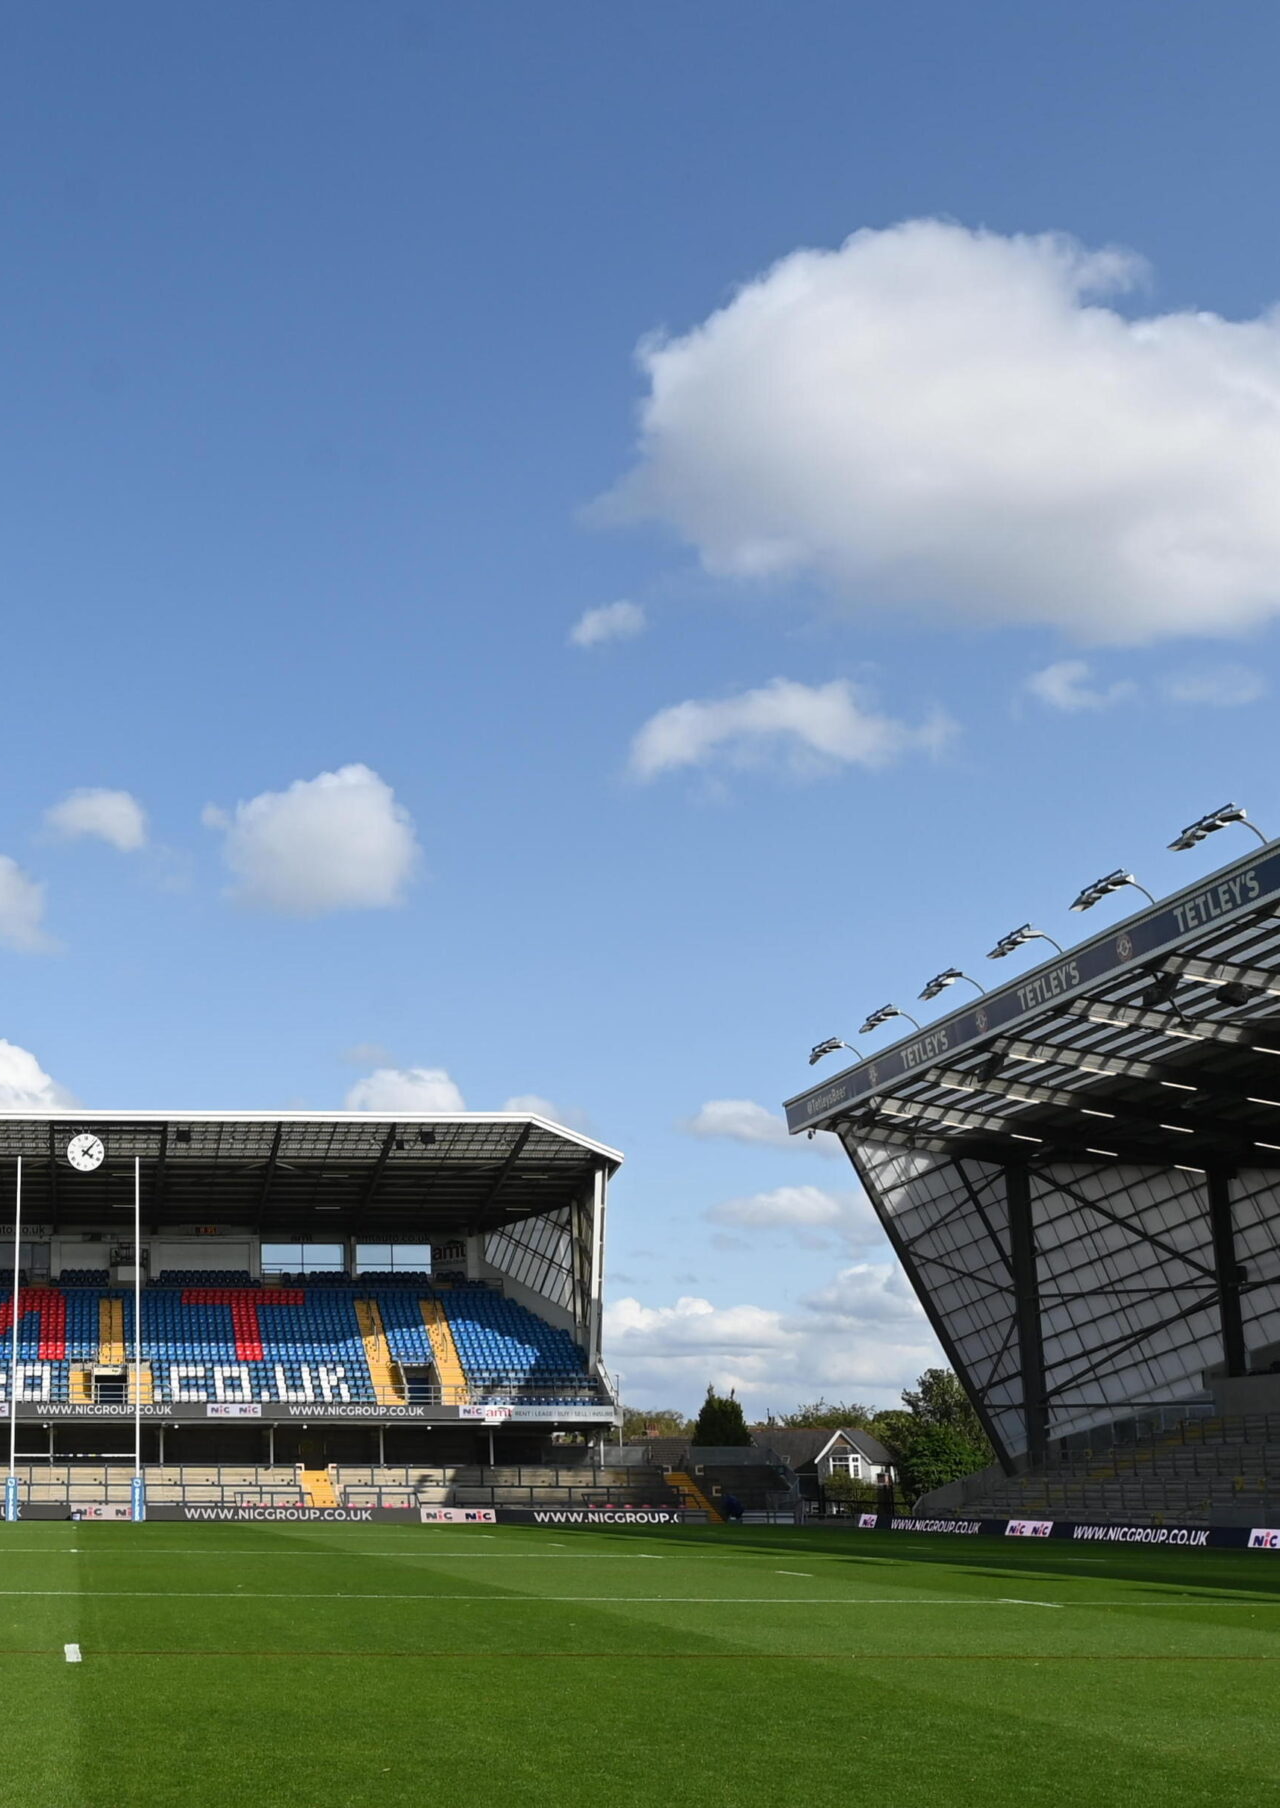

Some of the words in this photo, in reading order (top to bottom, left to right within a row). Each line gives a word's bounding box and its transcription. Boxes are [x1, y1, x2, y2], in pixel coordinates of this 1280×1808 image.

[1173, 870, 1260, 933] TETLEY'S
[1017, 961, 1080, 1011] TETLEY'S
[900, 1031, 949, 1070] TETLEY'S
[433, 1243, 466, 1261] amt
[37, 1404, 172, 1414] WWW.NICGROUP.CO.UK
[289, 1404, 424, 1414] WWW.NICGROUP.CO.UK
[184, 1507, 373, 1520] WWW.NICGROUP.CO.UK
[891, 1519, 982, 1534] WWW.NICGROUP.CO.UK
[1073, 1525, 1210, 1546] WWW.NICGROUP.CO.UK
